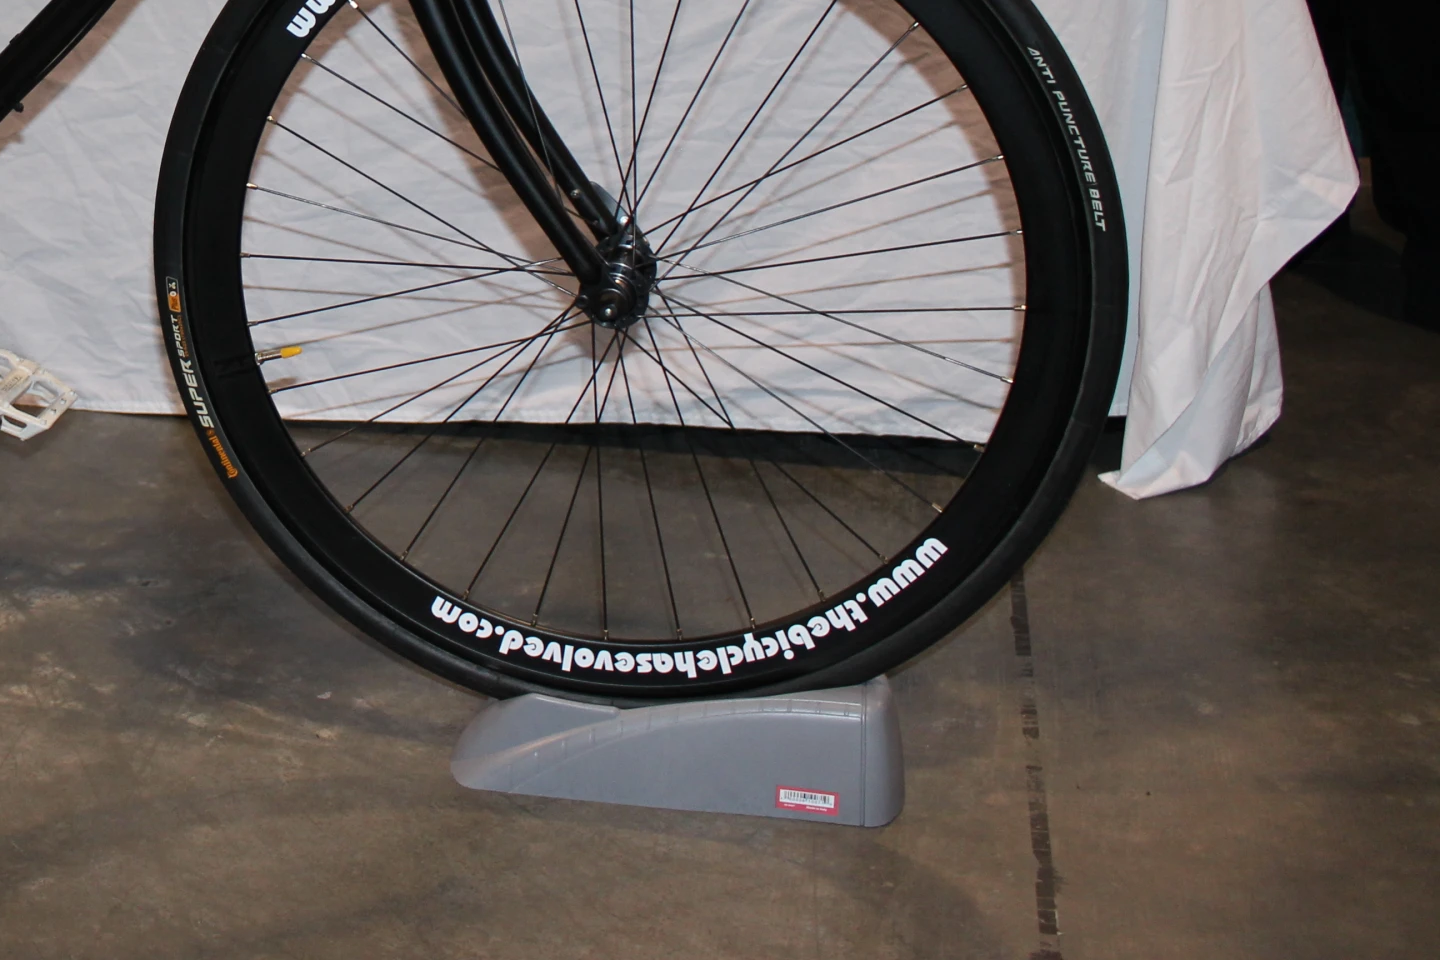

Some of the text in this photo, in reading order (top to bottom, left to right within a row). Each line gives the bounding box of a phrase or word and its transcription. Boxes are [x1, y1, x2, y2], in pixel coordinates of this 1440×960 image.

[1027, 46, 1106, 231] ANTI PUNCTURE BELT
[170, 314, 186, 358] SPORT
[179, 360, 215, 428] SUPER
[431, 537, 949, 678] www.thebicyclehasevolved.com
